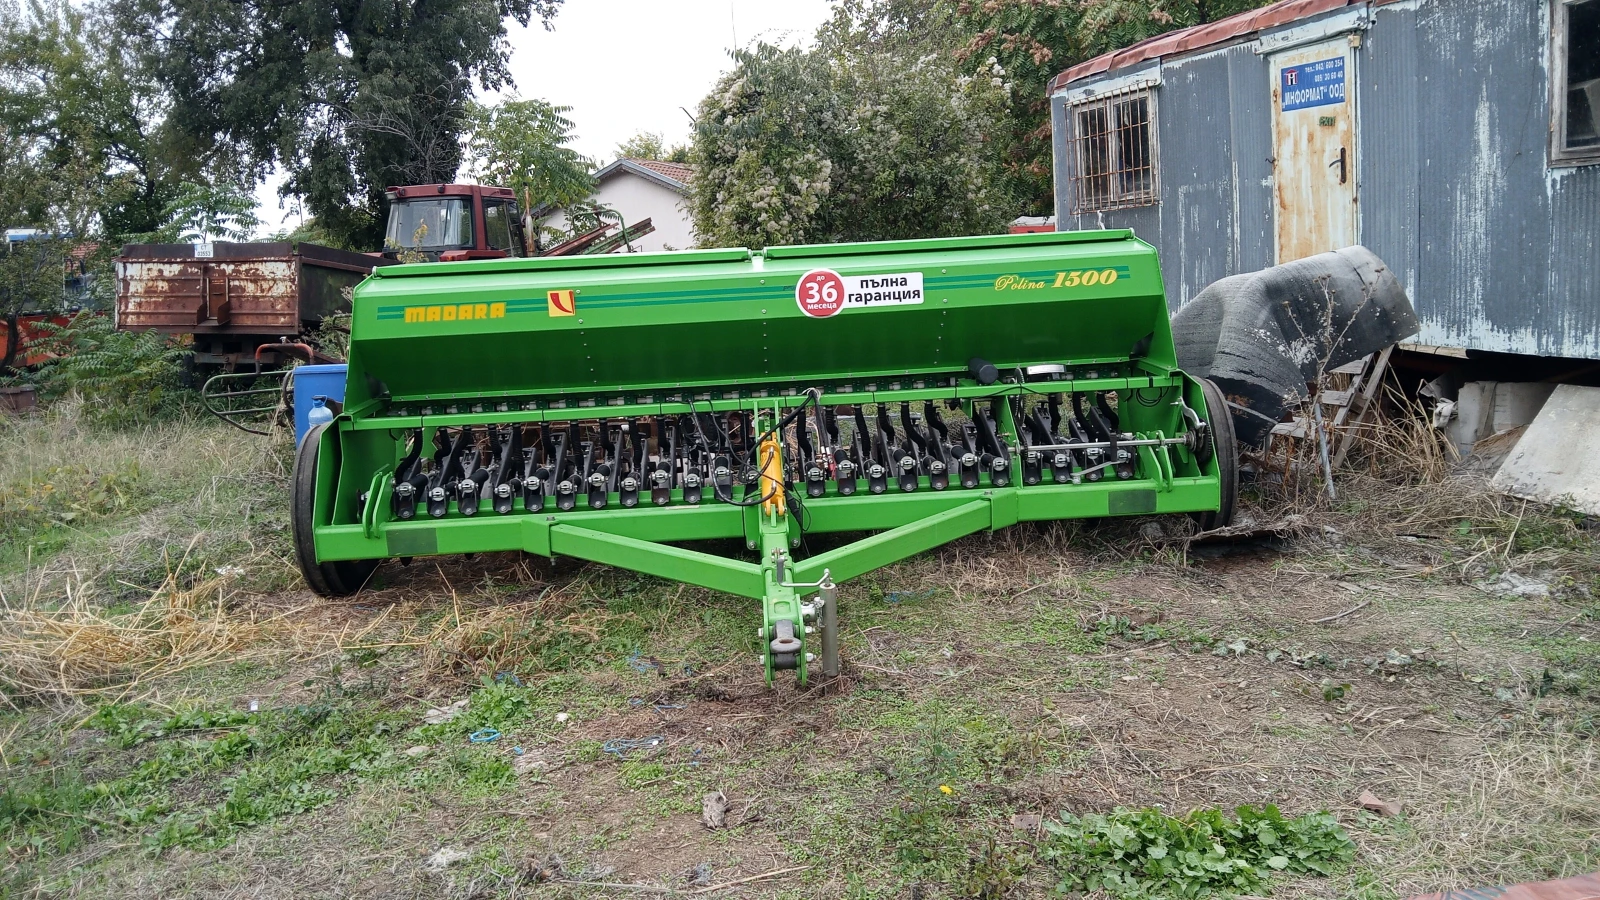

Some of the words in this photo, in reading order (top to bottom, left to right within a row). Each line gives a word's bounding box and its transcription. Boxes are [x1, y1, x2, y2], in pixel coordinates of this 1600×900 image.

[1329, 82, 1345, 100] ООД
[860, 277, 908, 289] пълна
[995, 274, 1046, 291] Polina
[1051, 268, 1118, 288] 1500
[805, 281, 838, 304] 36
[848, 289, 921, 305] гаранция
[404, 302, 506, 323] MADARA
[807, 302, 837, 310] месеца
